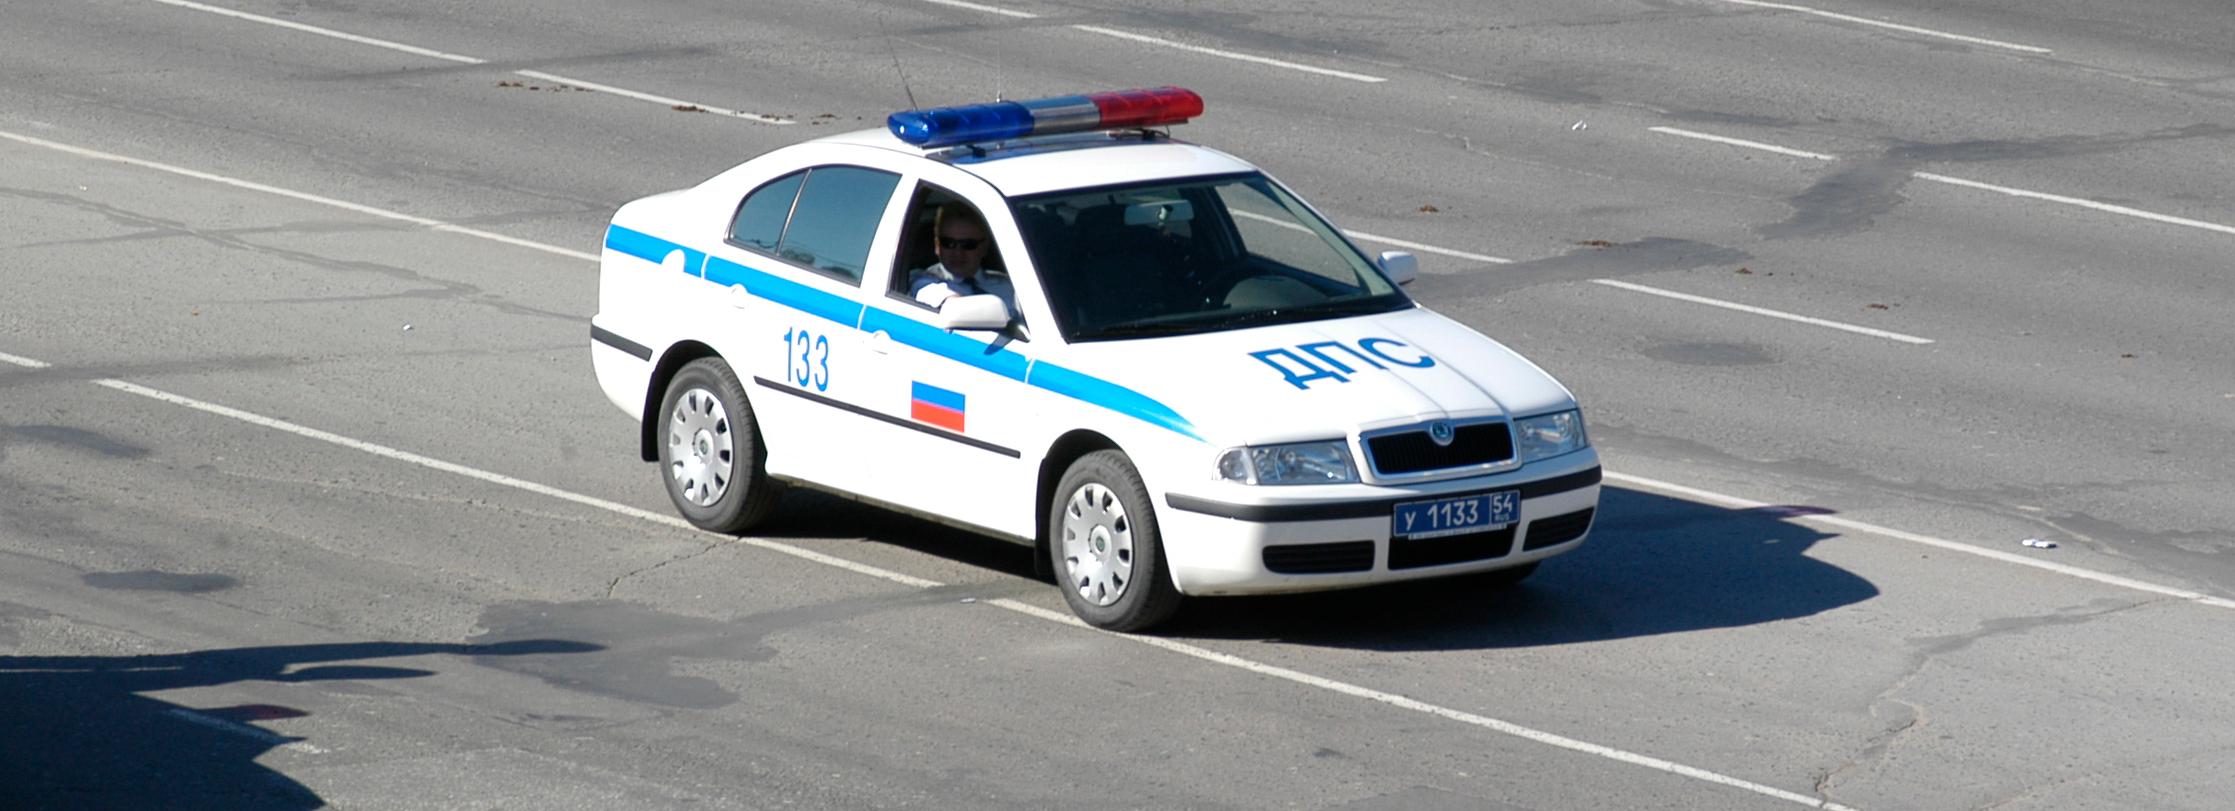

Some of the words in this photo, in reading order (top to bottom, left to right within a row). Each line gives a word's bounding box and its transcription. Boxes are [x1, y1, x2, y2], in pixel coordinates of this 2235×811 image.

[783, 326, 829, 392] 133
[1247, 337, 1436, 390] ДПС
[1427, 500, 1479, 529] 1133
[1492, 494, 1513, 514] 54
